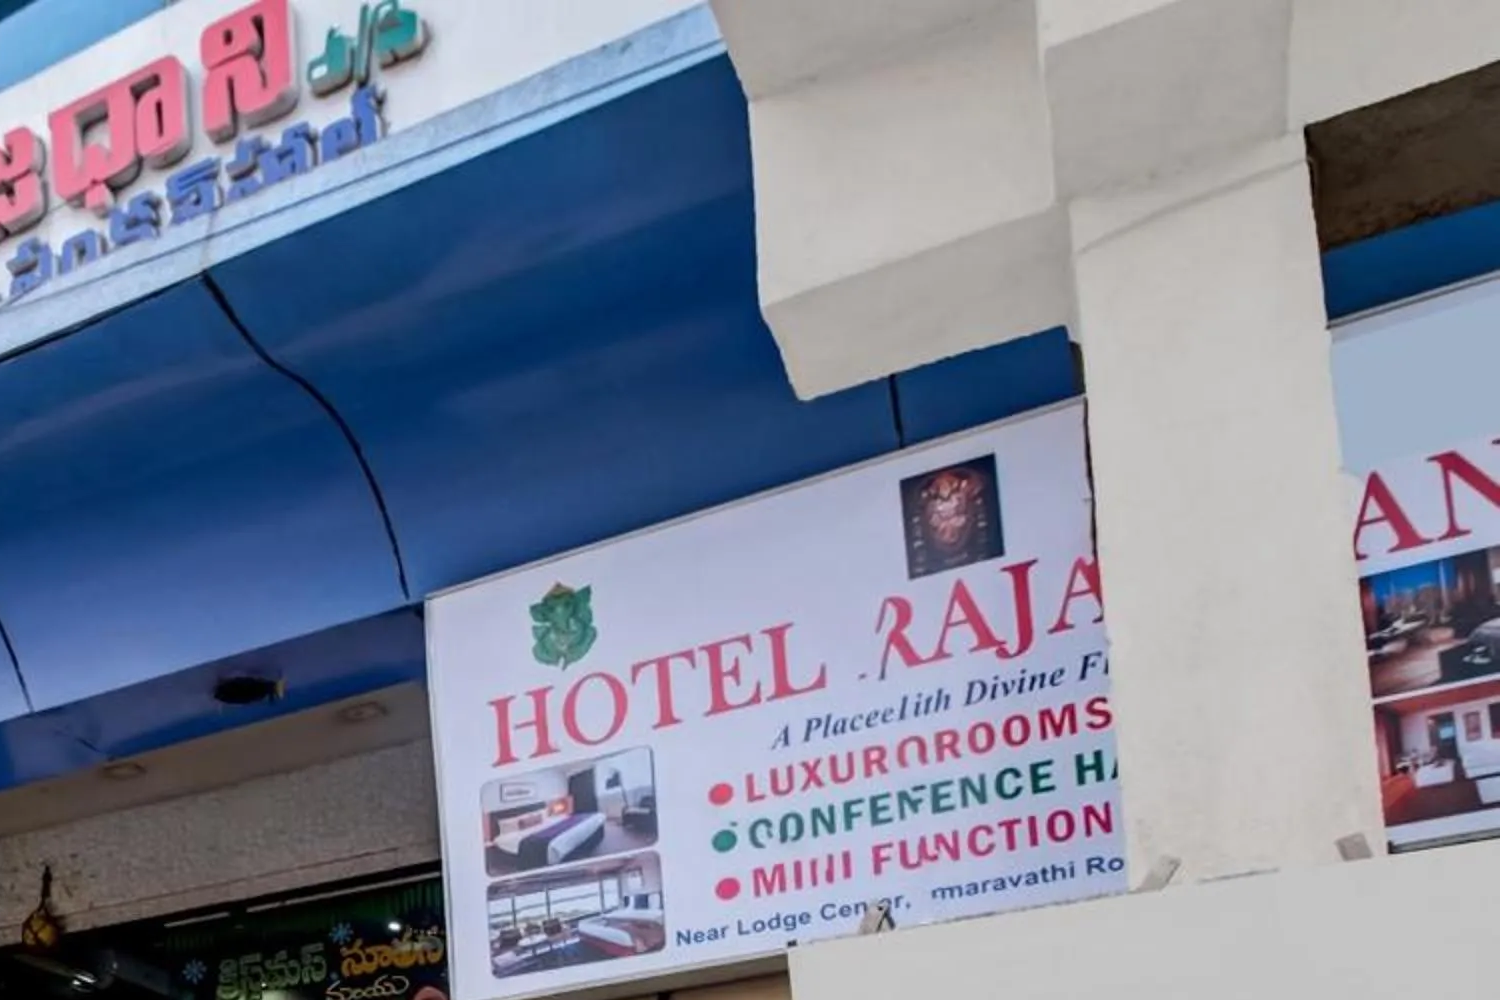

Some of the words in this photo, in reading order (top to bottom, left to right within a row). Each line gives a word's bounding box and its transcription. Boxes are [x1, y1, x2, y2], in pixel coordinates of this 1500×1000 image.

[488, 622, 827, 767] HOTEL
[771, 725, 791, 751] A
[964, 666, 1065, 706] Divine
[675, 925, 729, 947] Near
[737, 910, 811, 932] Lodge
